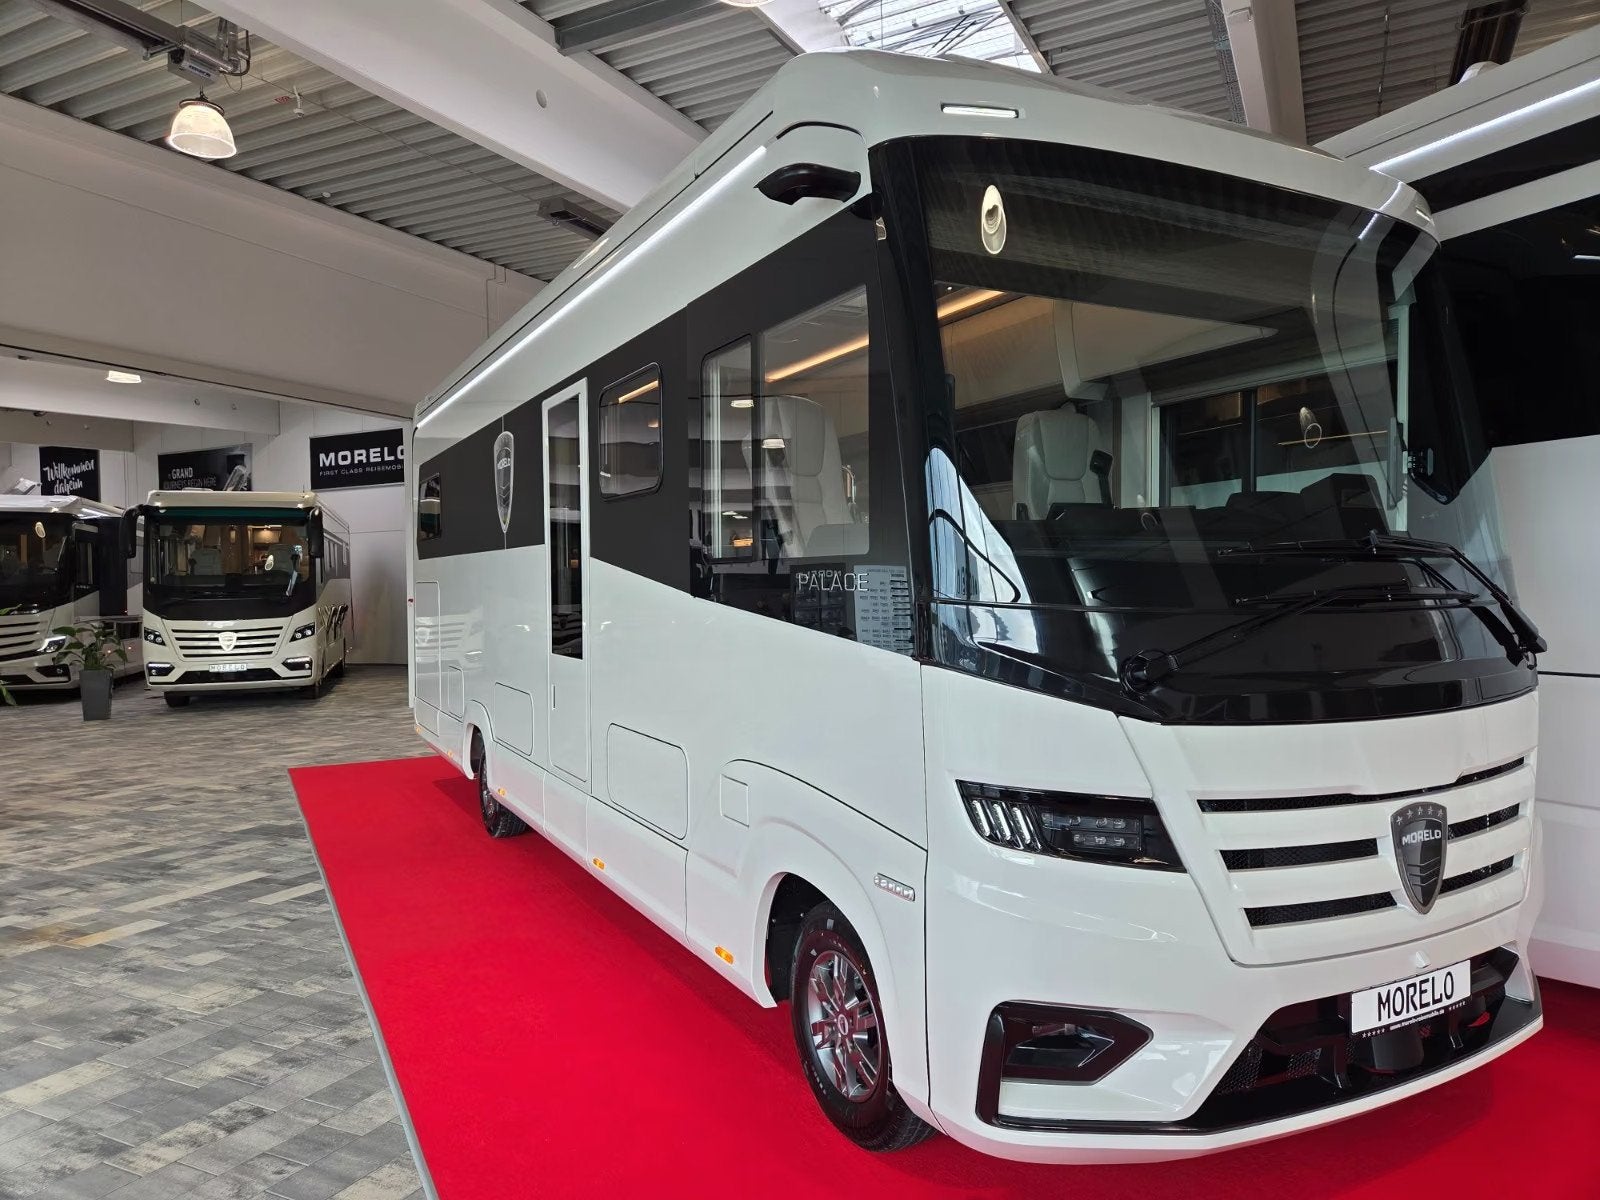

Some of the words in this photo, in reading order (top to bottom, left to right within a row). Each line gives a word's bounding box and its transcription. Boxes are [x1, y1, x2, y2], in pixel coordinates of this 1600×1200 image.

[171, 467, 194, 480] GRAND
[319, 469, 338, 477] FIRST
[340, 467, 363, 475] CLASS
[797, 572, 869, 592] PALACE
[1401, 829, 1442, 846] MORELO
[1377, 970, 1455, 1022] MORELO
